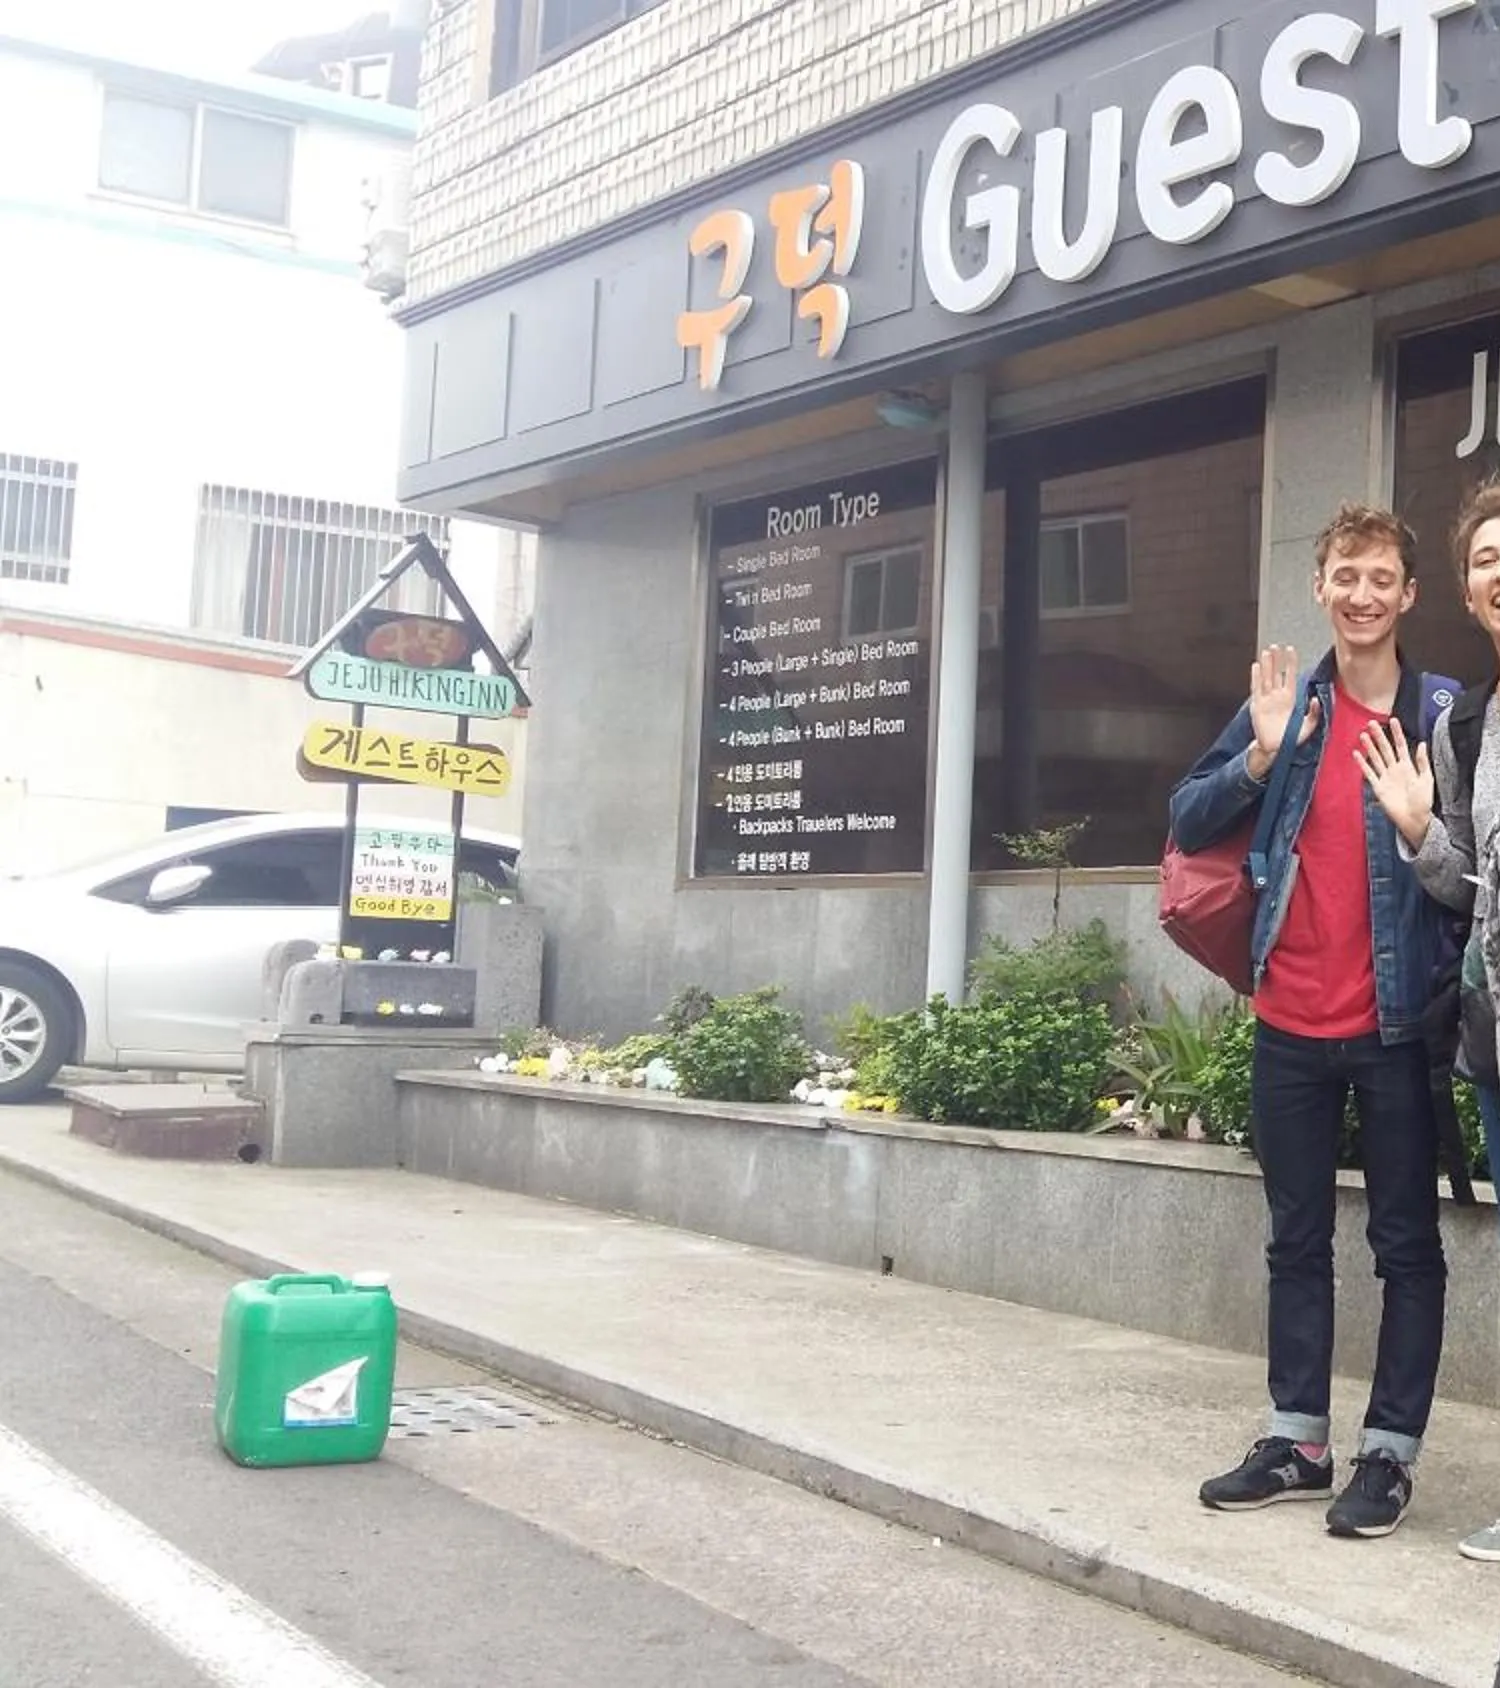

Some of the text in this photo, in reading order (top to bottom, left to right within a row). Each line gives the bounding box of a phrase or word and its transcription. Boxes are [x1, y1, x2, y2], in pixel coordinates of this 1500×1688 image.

[920, 0, 1475, 314] Guest
[677, 159, 864, 391] 구덕
[767, 490, 880, 538] Room Type
[736, 552, 766, 574] Single
[769, 550, 789, 568] Bed
[792, 545, 821, 563] Room
[761, 586, 781, 603] Bed
[784, 582, 813, 600] Room
[733, 624, 767, 643] Couple
[769, 620, 789, 637] Bed
[793, 617, 821, 633] Room
[731, 661, 739, 677] 3
[740, 658, 773, 678] People
[861, 641, 883, 661] Bed
[887, 639, 919, 657] Room
[327, 661, 508, 711] JEJU HIKINGINN
[729, 697, 737, 712] 4
[738, 694, 771, 713] People
[853, 680, 876, 699] Bed
[879, 678, 910, 697] Room
[728, 732, 736, 747] 4
[736, 729, 770, 748] People
[848, 718, 871, 737] Bed
[873, 717, 905, 735] Room
[320, 727, 502, 785] 게스트하우스
[739, 816, 794, 837] Backpacks
[847, 812, 896, 831] Welcome
[360, 853, 438, 873] Thank You
[355, 897, 435, 916] Good Bye
